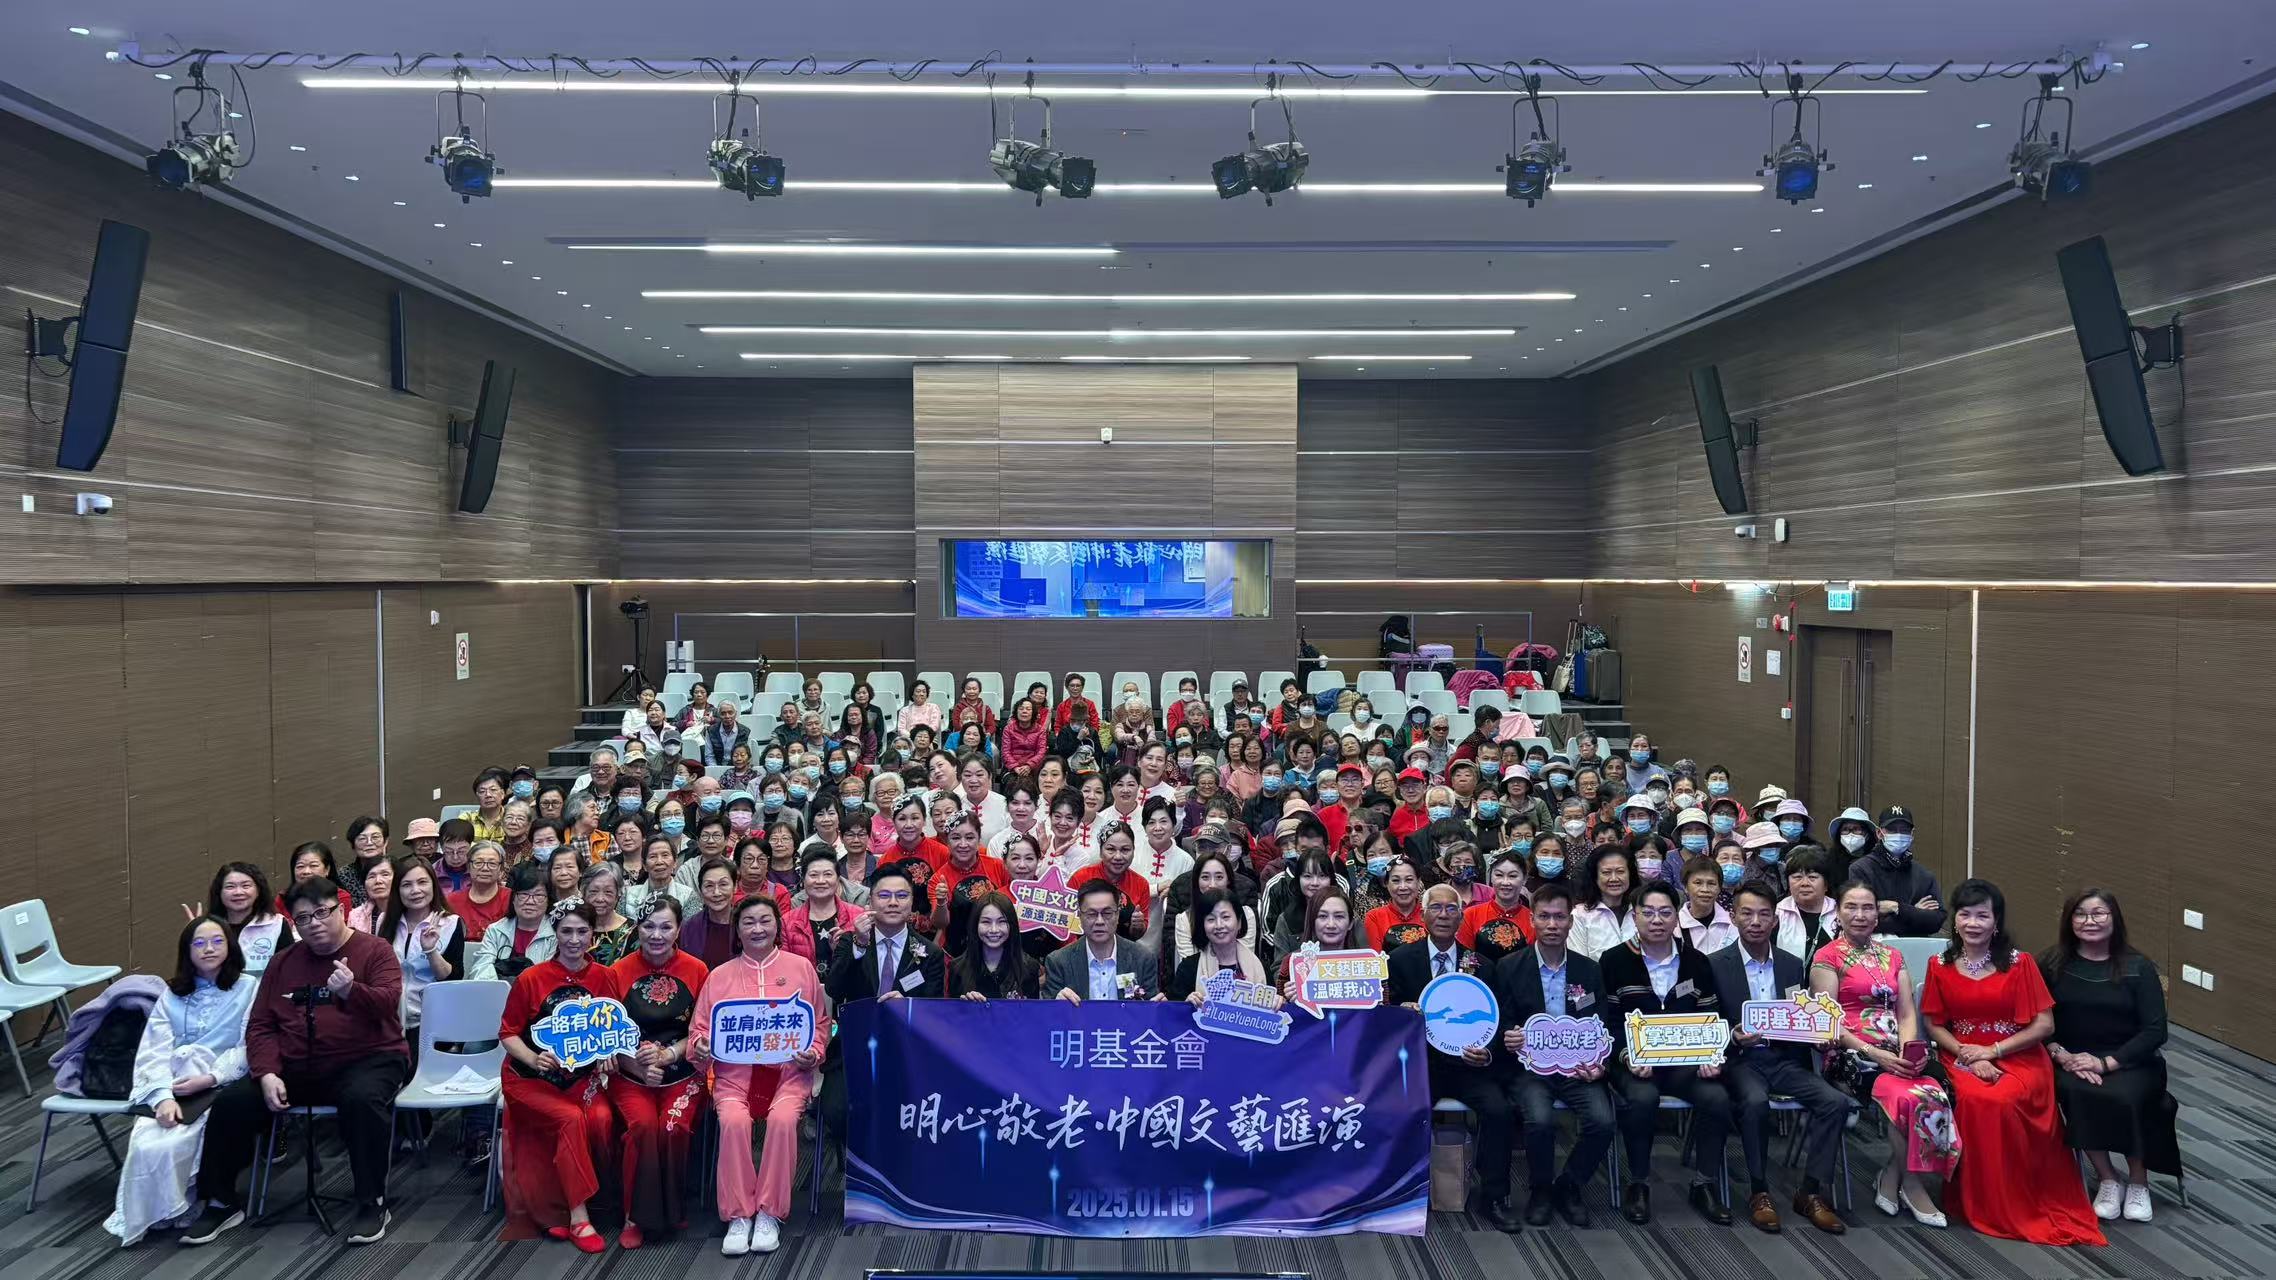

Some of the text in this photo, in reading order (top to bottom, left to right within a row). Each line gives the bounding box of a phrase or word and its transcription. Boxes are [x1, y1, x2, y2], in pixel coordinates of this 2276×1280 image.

[1017, 884, 1079, 910] 中國文化
[1021, 906, 1069, 926] 源遠流長
[1321, 960, 1382, 977] 文藝匯演
[1231, 980, 1276, 1010] 元朗
[532, 1001, 618, 1034] 一路有你
[720, 1012, 804, 1033] 並肩的未來
[1749, 1006, 1833, 1033] 明基金會
[563, 1027, 639, 1056] 同心同行
[725, 1032, 801, 1053] 閃閃發光
[1440, 1041, 1460, 1053] FUND
[1481, 1027, 1494, 1043] 2011
[1526, 1029, 1597, 1050] 明心敬老
[1645, 1025, 1722, 1047] 掌聲雷動
[1050, 1028, 1210, 1071] 明基金會
[1067, 1187, 1194, 1218] 2025.01.15
